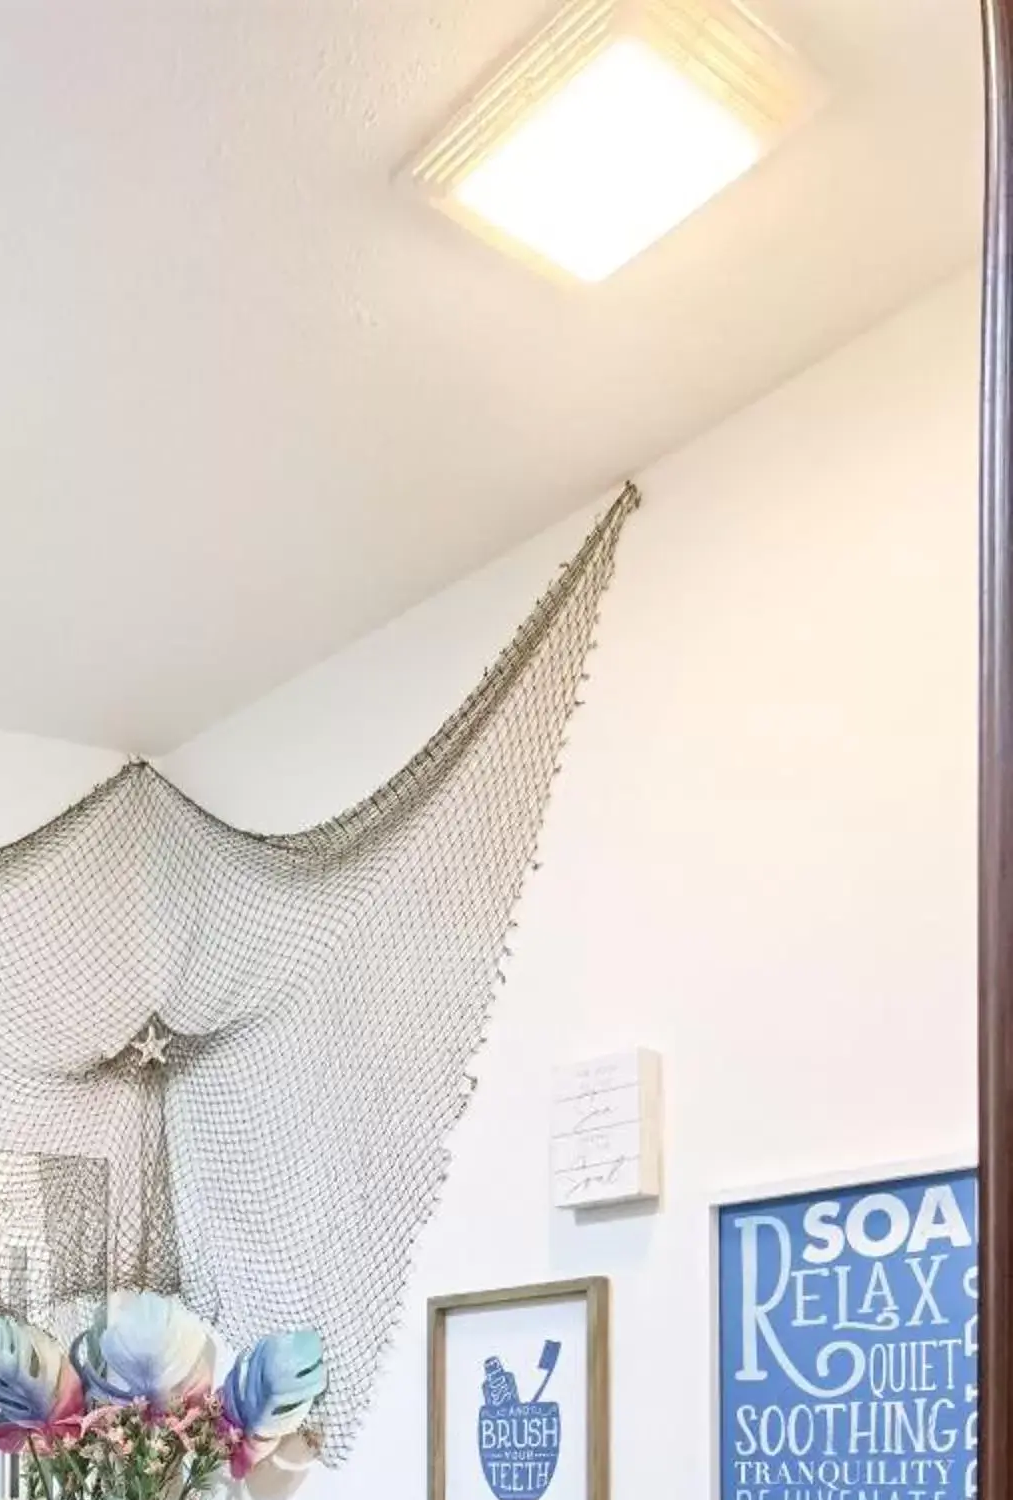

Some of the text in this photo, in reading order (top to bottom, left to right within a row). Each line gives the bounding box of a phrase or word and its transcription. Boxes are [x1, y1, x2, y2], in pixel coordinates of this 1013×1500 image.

[802, 1179, 979, 1264] SOA
[734, 1215, 950, 1398] RELAX
[869, 1338, 962, 1399] QUIET
[482, 1417, 558, 1449] BRUSH
[734, 1397, 959, 1457] SOOTHING
[487, 1461, 551, 1491] TEETH
[734, 1459, 956, 1490] TRANQUILITY
